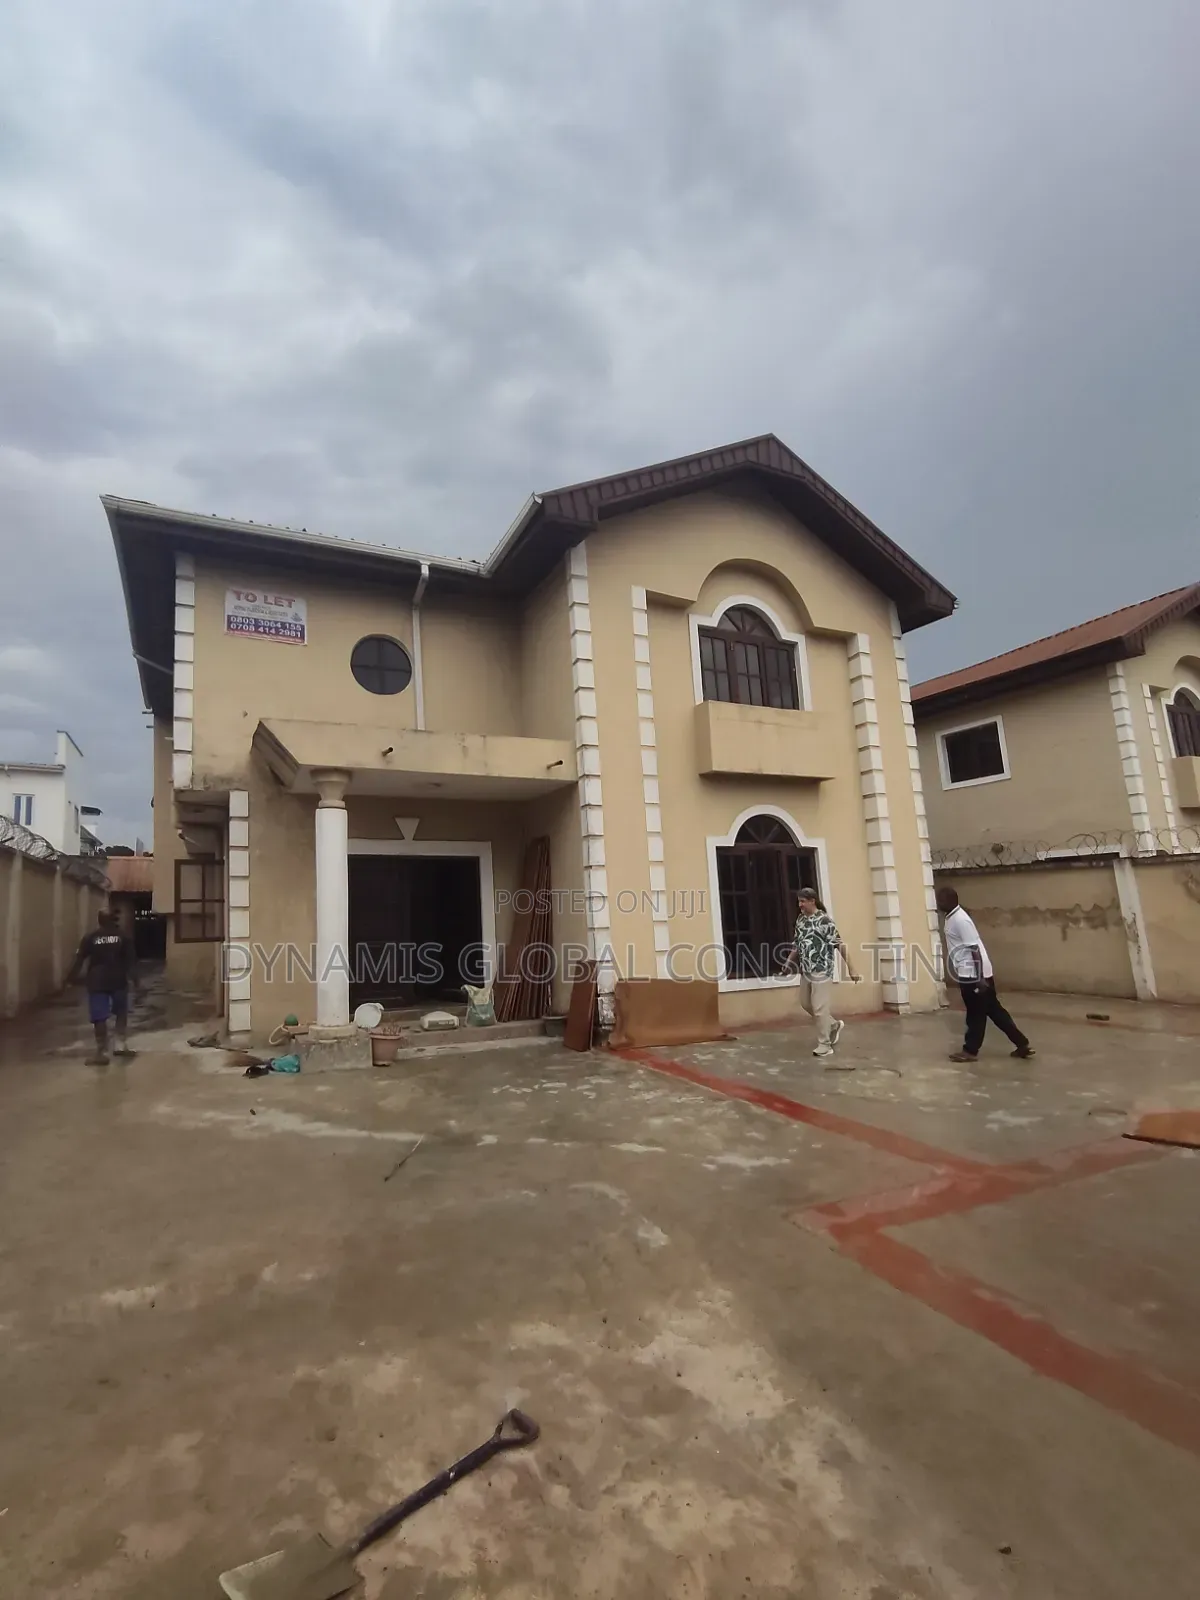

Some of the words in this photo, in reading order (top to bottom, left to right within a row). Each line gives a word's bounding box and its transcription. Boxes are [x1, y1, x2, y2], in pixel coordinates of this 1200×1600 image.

[232, 589, 258, 604] TO
[263, 594, 296, 609] LET
[230, 616, 255, 625] 0803
[230, 623, 255, 632] 0708
[258, 626, 276, 634] 414
[279, 628, 301, 637] 2981
